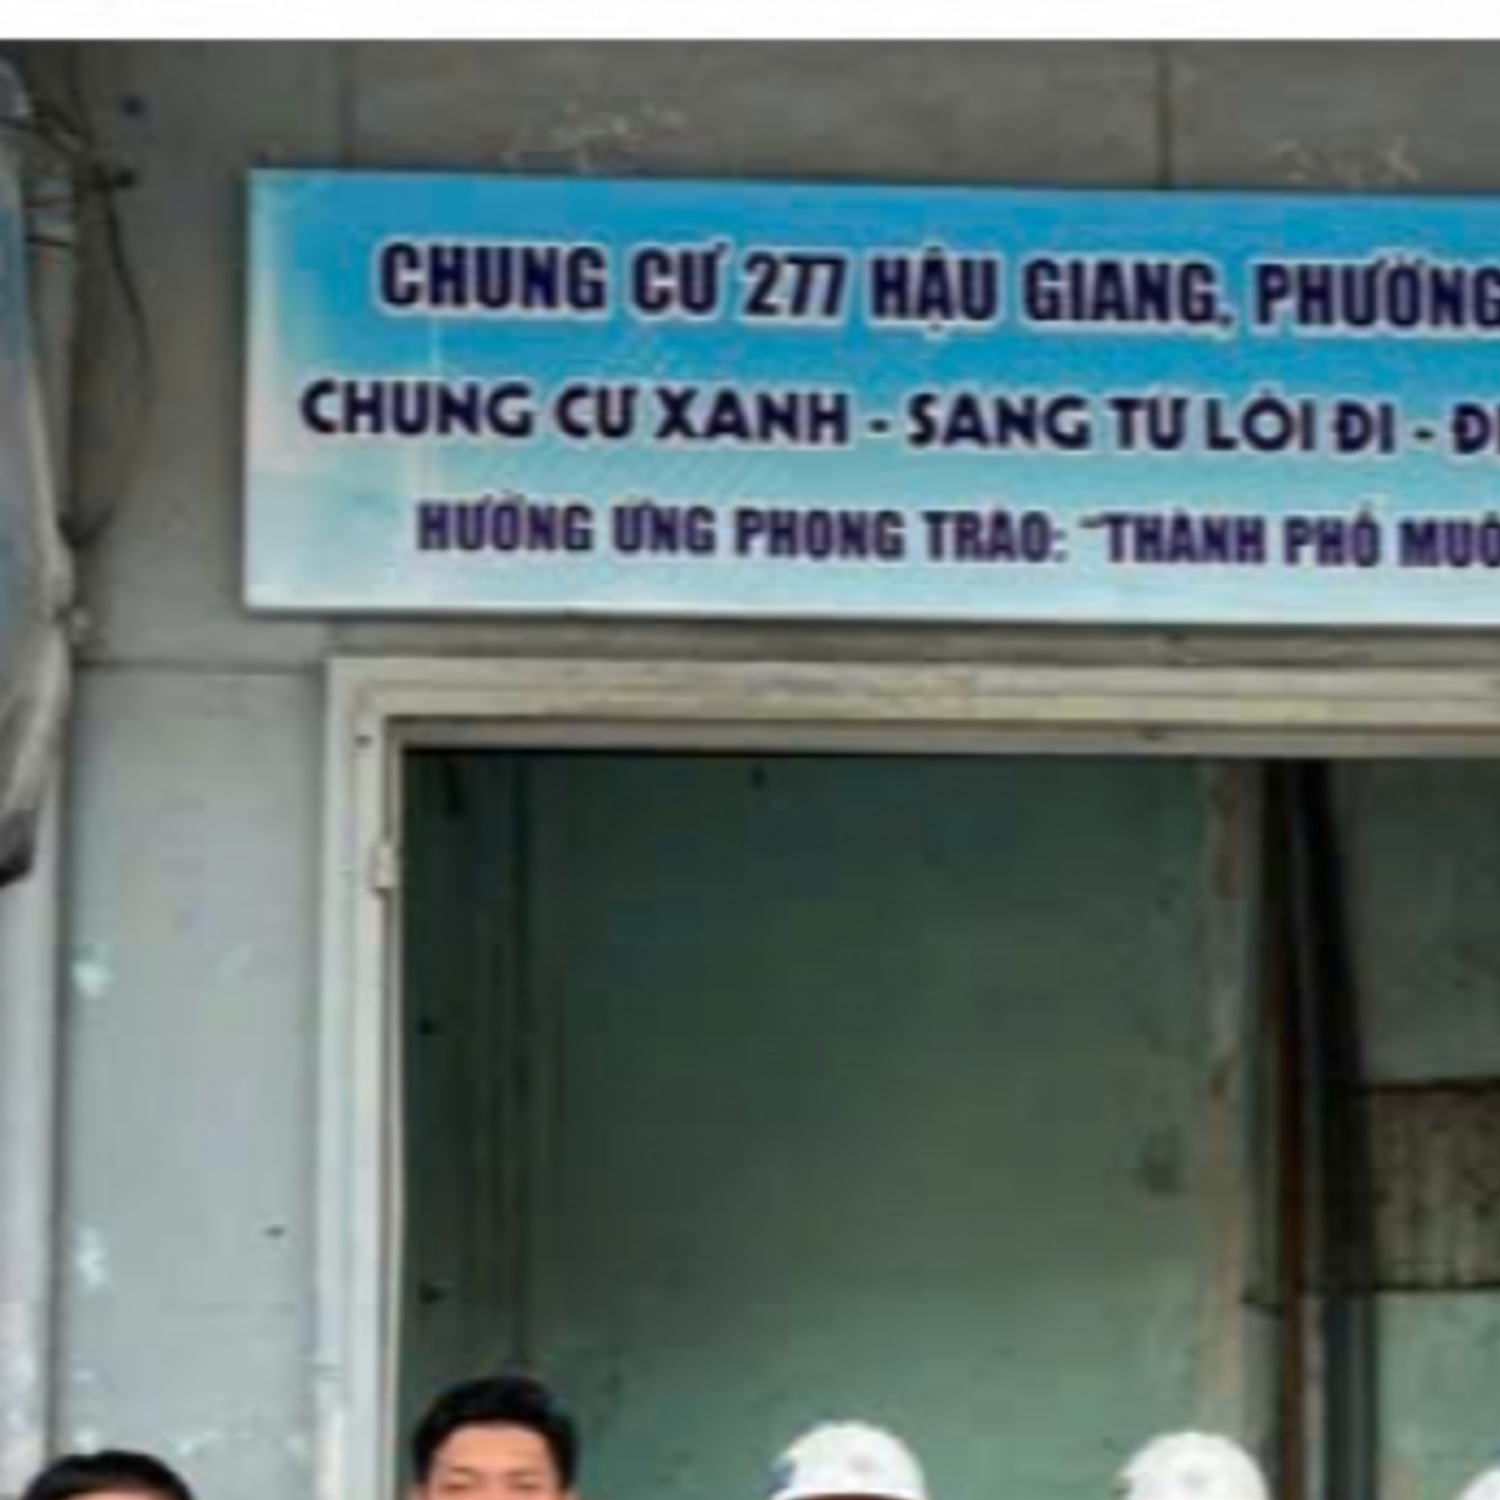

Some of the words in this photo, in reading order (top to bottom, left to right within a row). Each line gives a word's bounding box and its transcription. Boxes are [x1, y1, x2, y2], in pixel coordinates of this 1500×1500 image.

[380, 241, 606, 311] CHUNG
[631, 241, 732, 315] CƯ
[743, 250, 847, 317] 277
[1022, 257, 1234, 328] GIANG,
[300, 378, 534, 439] CHUNG
[654, 388, 849, 446] XANH
[732, 506, 905, 560] PHONG
